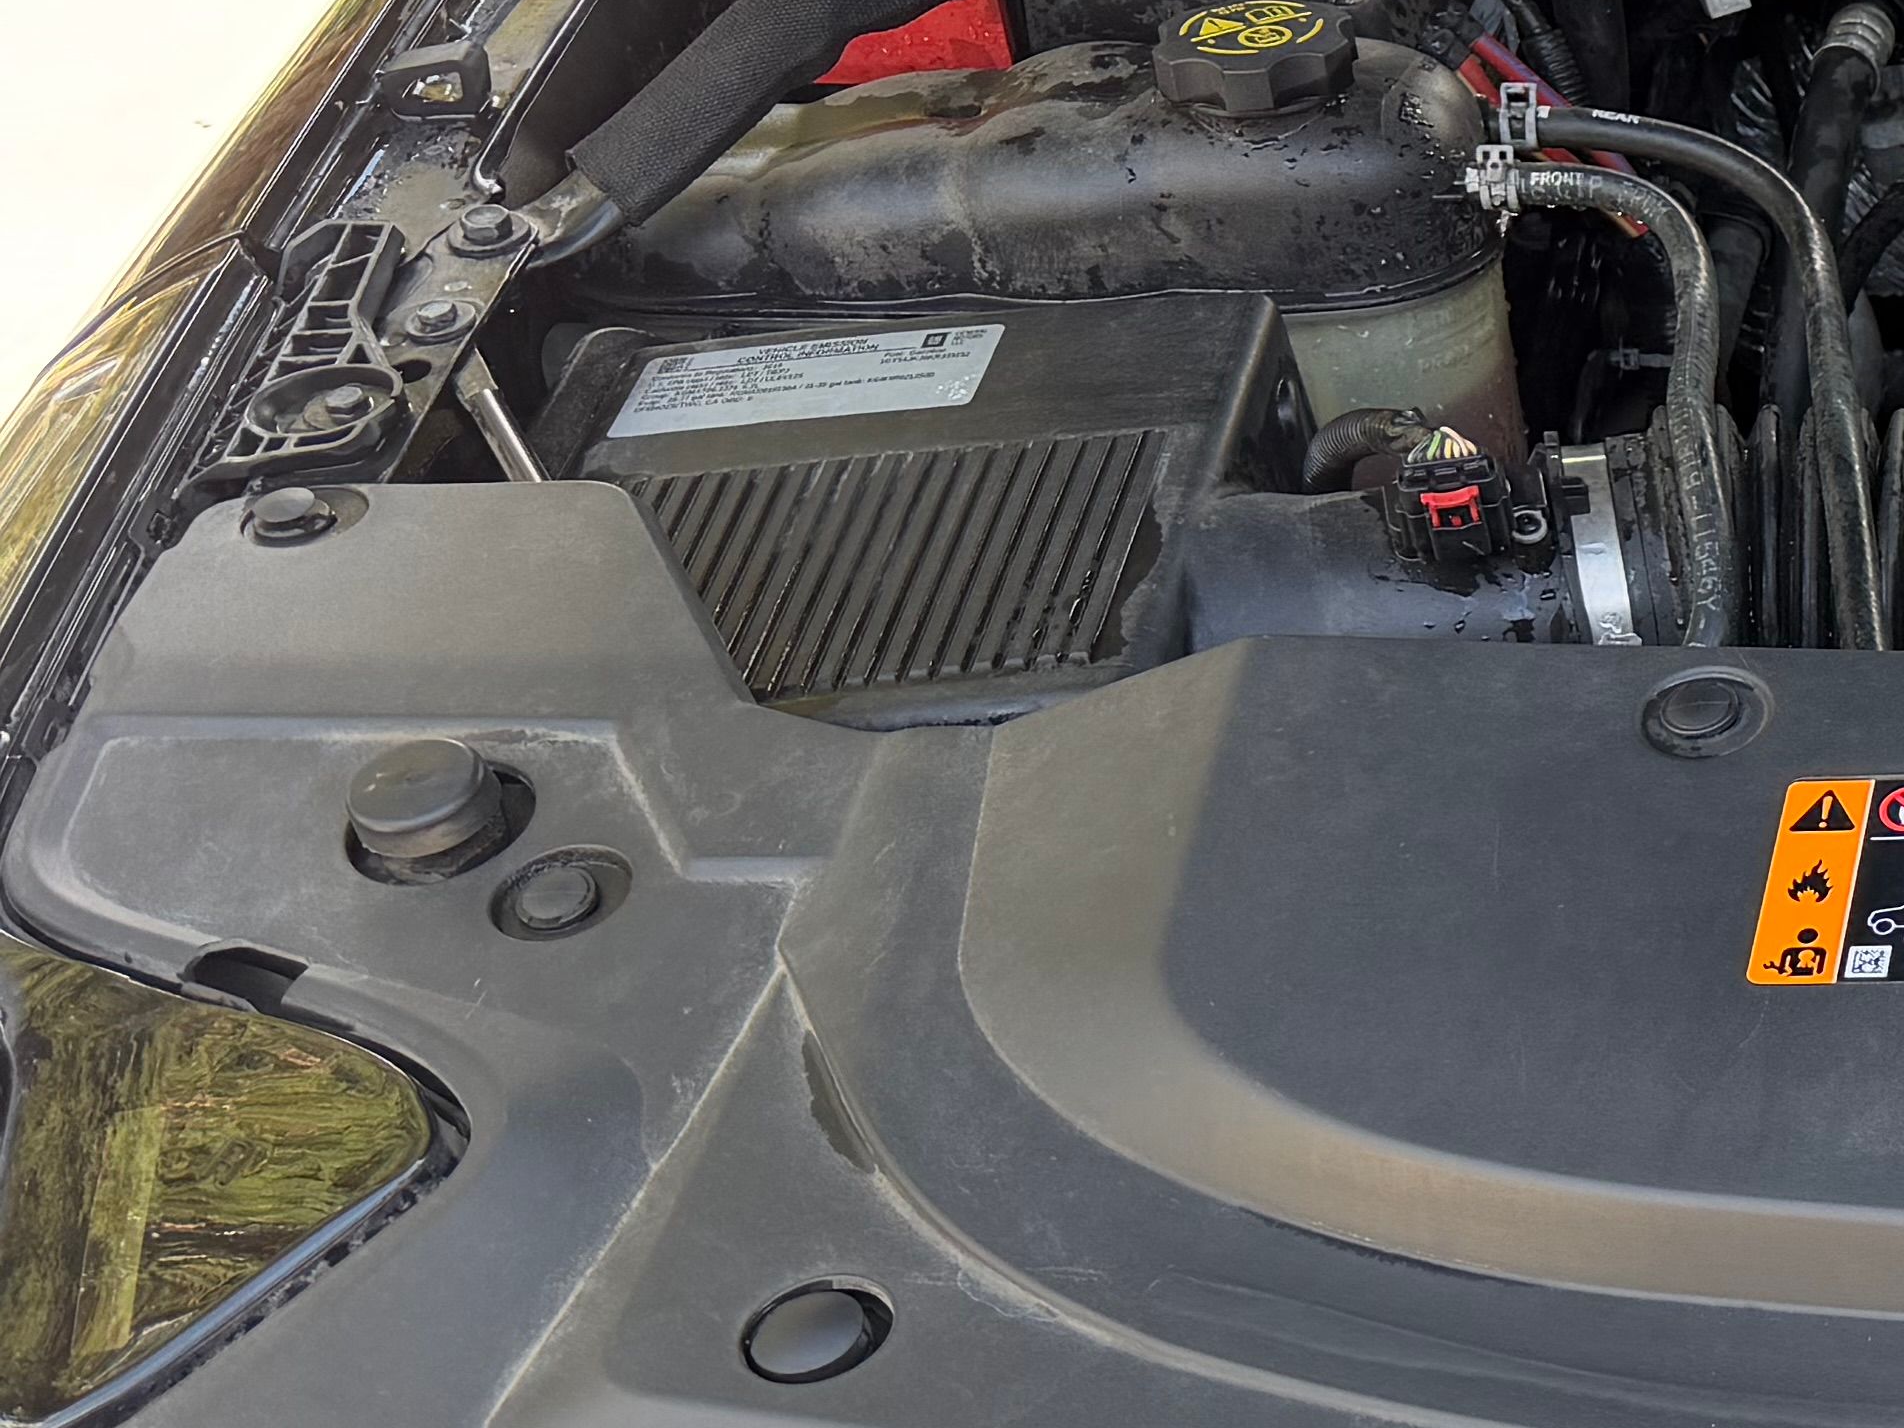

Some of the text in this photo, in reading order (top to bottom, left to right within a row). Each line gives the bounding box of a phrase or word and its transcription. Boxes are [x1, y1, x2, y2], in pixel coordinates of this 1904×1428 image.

[1592, 109, 1641, 124] REAR
[1530, 172, 1584, 186] FRONT
[737, 353, 793, 364] CONTROL
[797, 344, 879, 358] INFORMATION
[759, 338, 869, 355] VEHICLE EMISSION
